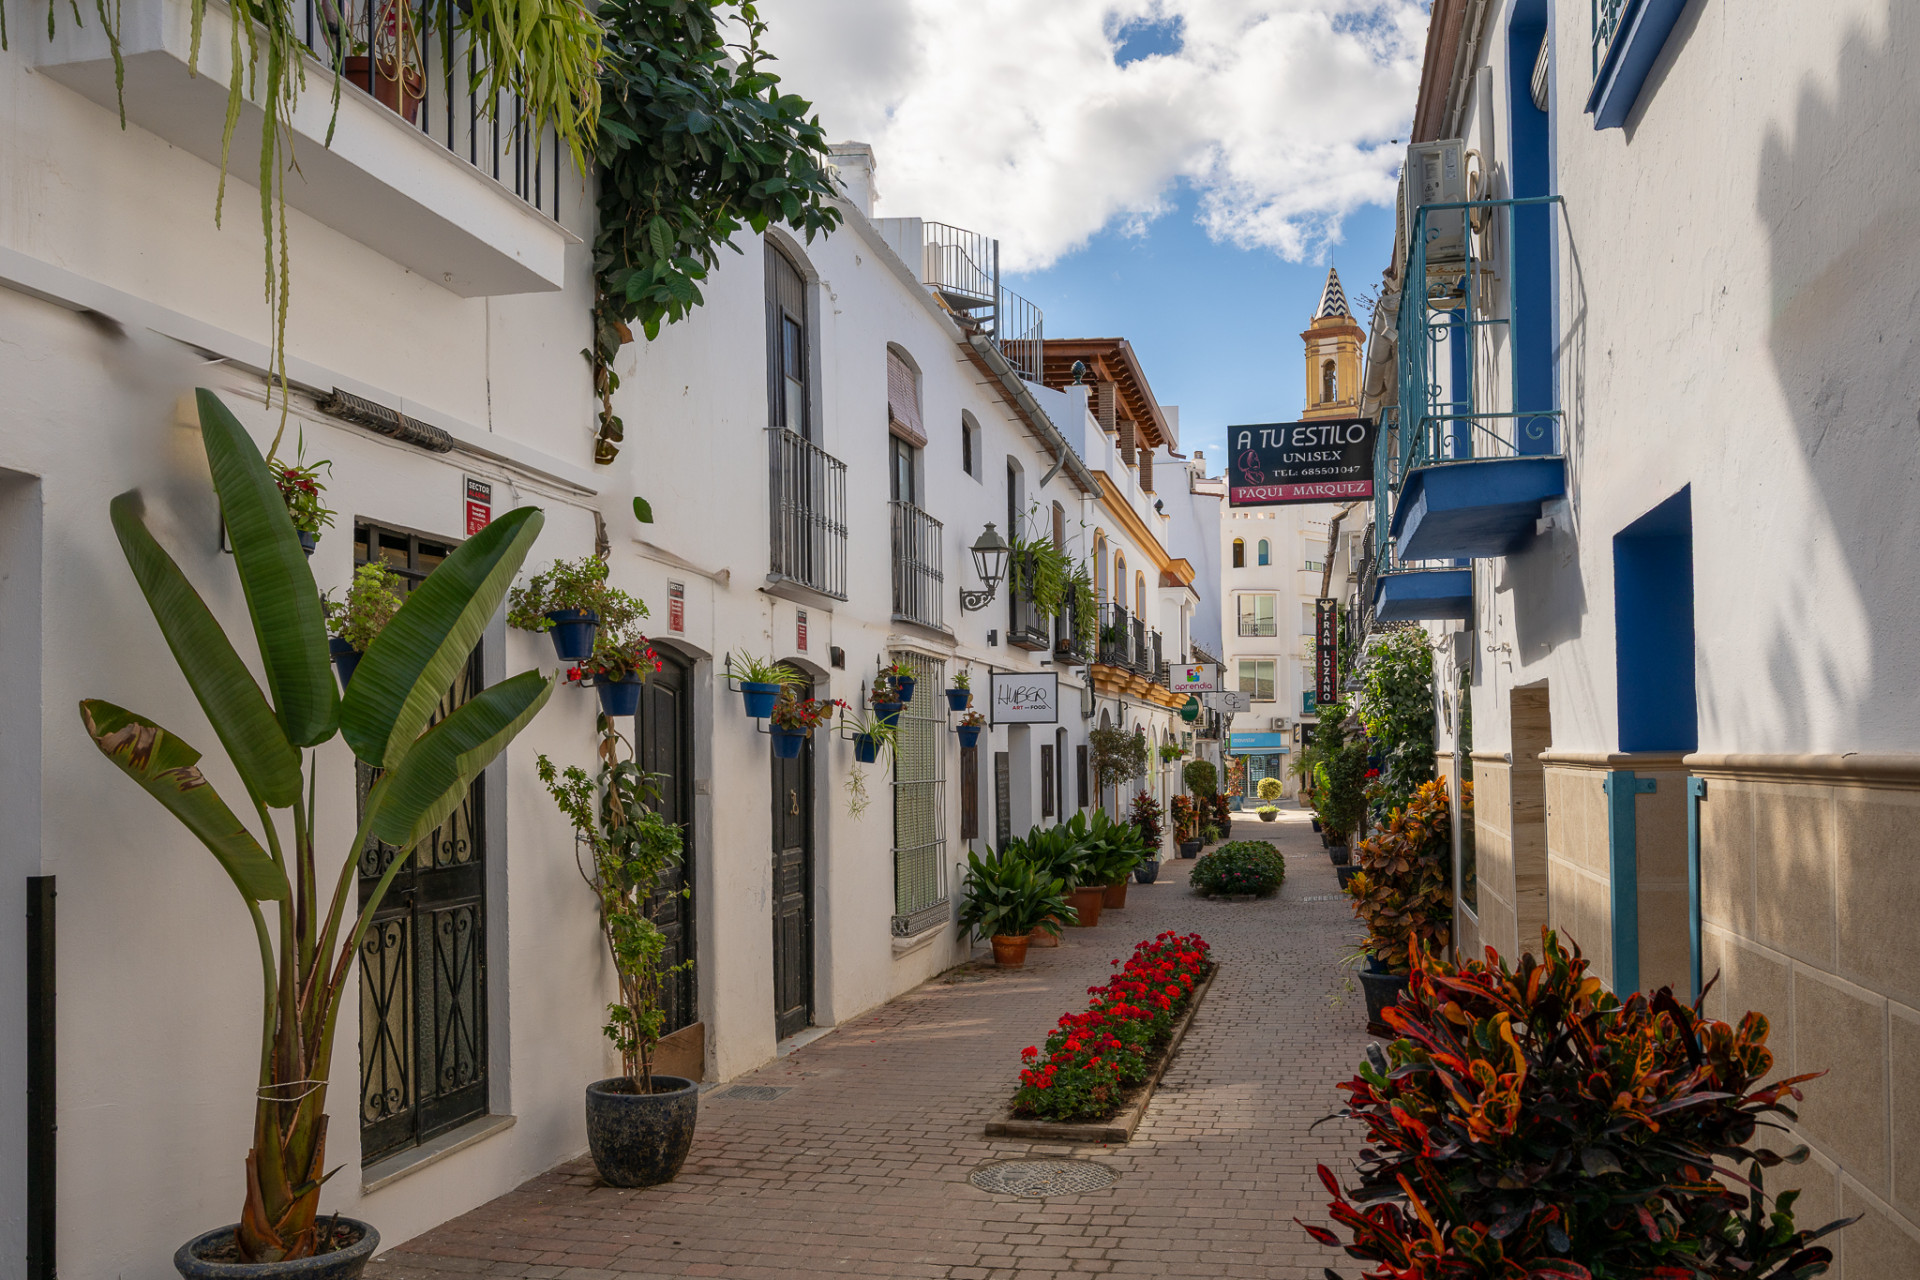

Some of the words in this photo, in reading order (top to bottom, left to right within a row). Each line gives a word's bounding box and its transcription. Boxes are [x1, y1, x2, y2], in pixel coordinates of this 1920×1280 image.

[1237, 430, 1251, 450] A
[1259, 428, 1285, 448] TU
[1291, 424, 1366, 447] ESTILO
[1282, 450, 1342, 463] UNISEX
[1272, 469, 1299, 477] TEL:
[1301, 465, 1361, 476] 685501047
[468, 481, 490, 494] SECTOR
[1239, 487, 1283, 499] PAQUI
[1293, 482, 1366, 497] MARQUEZ
[1174, 682, 1213, 691] aprendia
[997, 683, 1052, 710] HUBER
